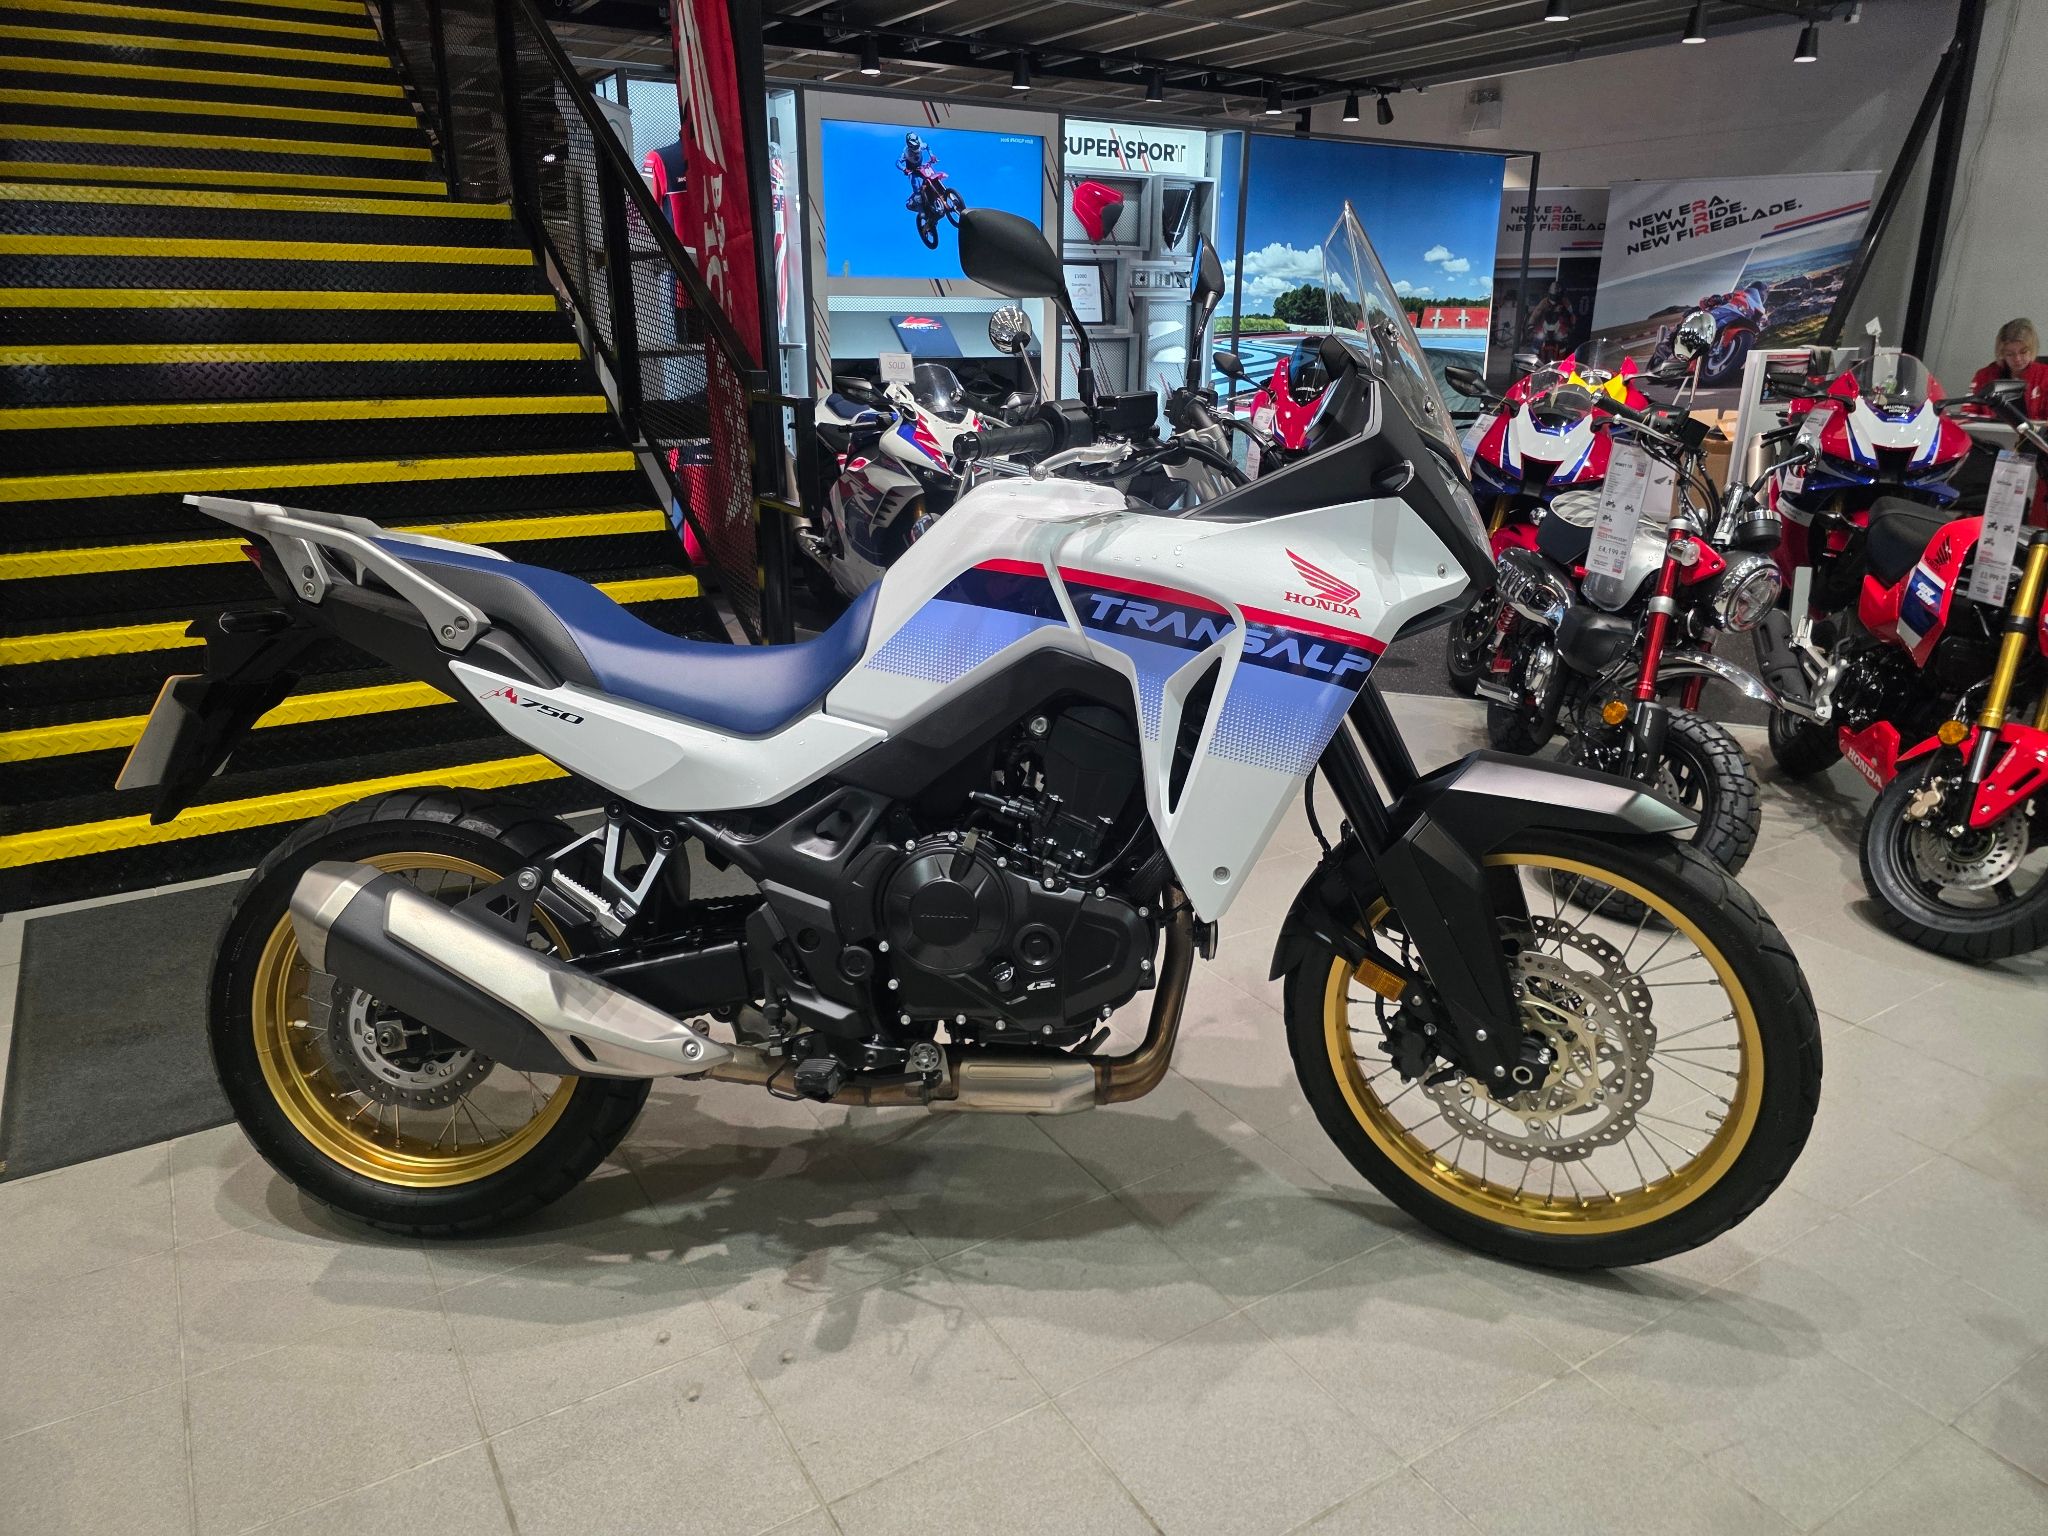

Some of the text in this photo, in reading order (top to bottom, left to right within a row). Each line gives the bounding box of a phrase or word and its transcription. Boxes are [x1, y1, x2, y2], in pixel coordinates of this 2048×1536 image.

[1125, 140, 1186, 163] SPORT
[1518, 214, 1586, 223] NW RIDE.
[1544, 205, 1577, 214] ERA.
[1628, 195, 1730, 231] NEW ERA.
[1642, 201, 1748, 239] NEW RIDE.
[1539, 222, 1607, 232] FIREBLAD
[1626, 198, 1803, 256] NEW FIREBLADE.
[888, 360, 906, 370] SOLD
[1283, 590, 1362, 619] HONDA
[1089, 593, 1372, 676] TRANSALP
[520, 697, 585, 725] 750
[1846, 746, 1882, 788] HONDA
